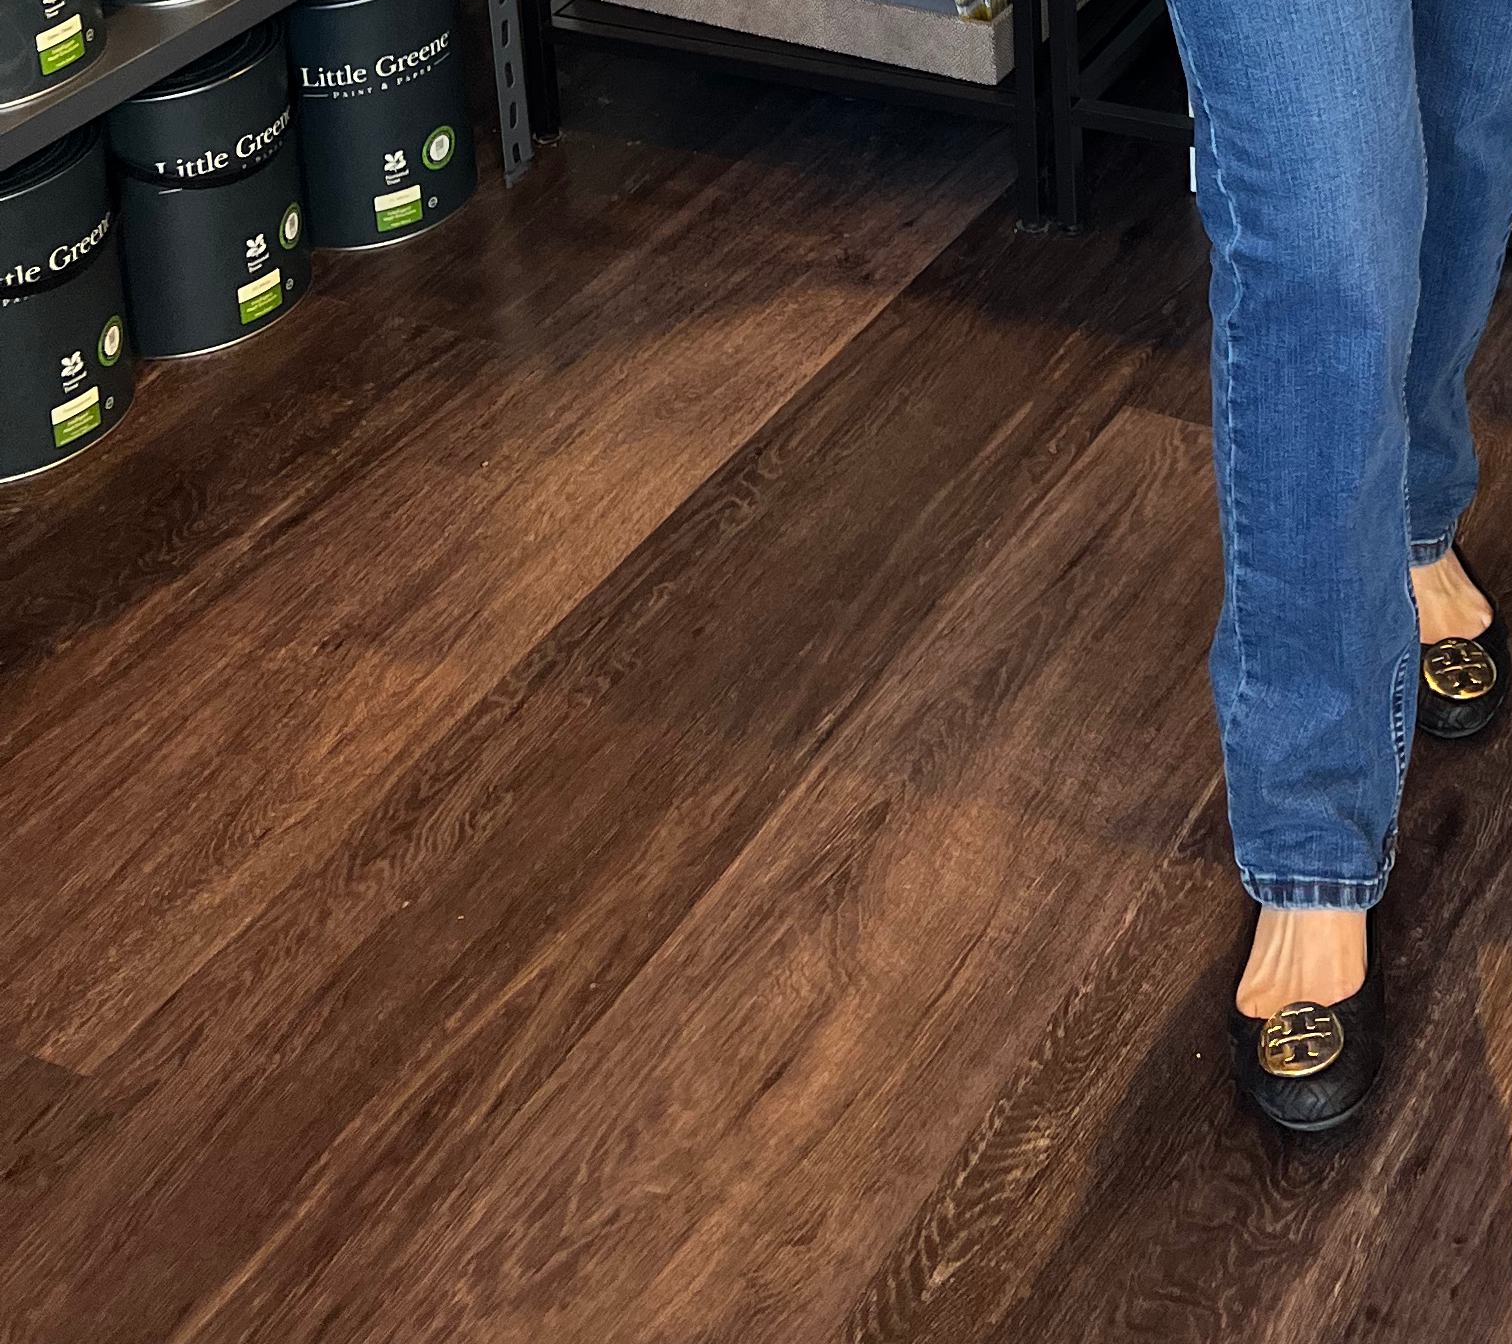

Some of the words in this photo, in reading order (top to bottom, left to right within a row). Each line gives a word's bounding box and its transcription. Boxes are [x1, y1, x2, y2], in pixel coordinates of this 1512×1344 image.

[301, 65, 367, 88] Little
[375, 31, 450, 78] Greene
[332, 86, 373, 100] PAINT
